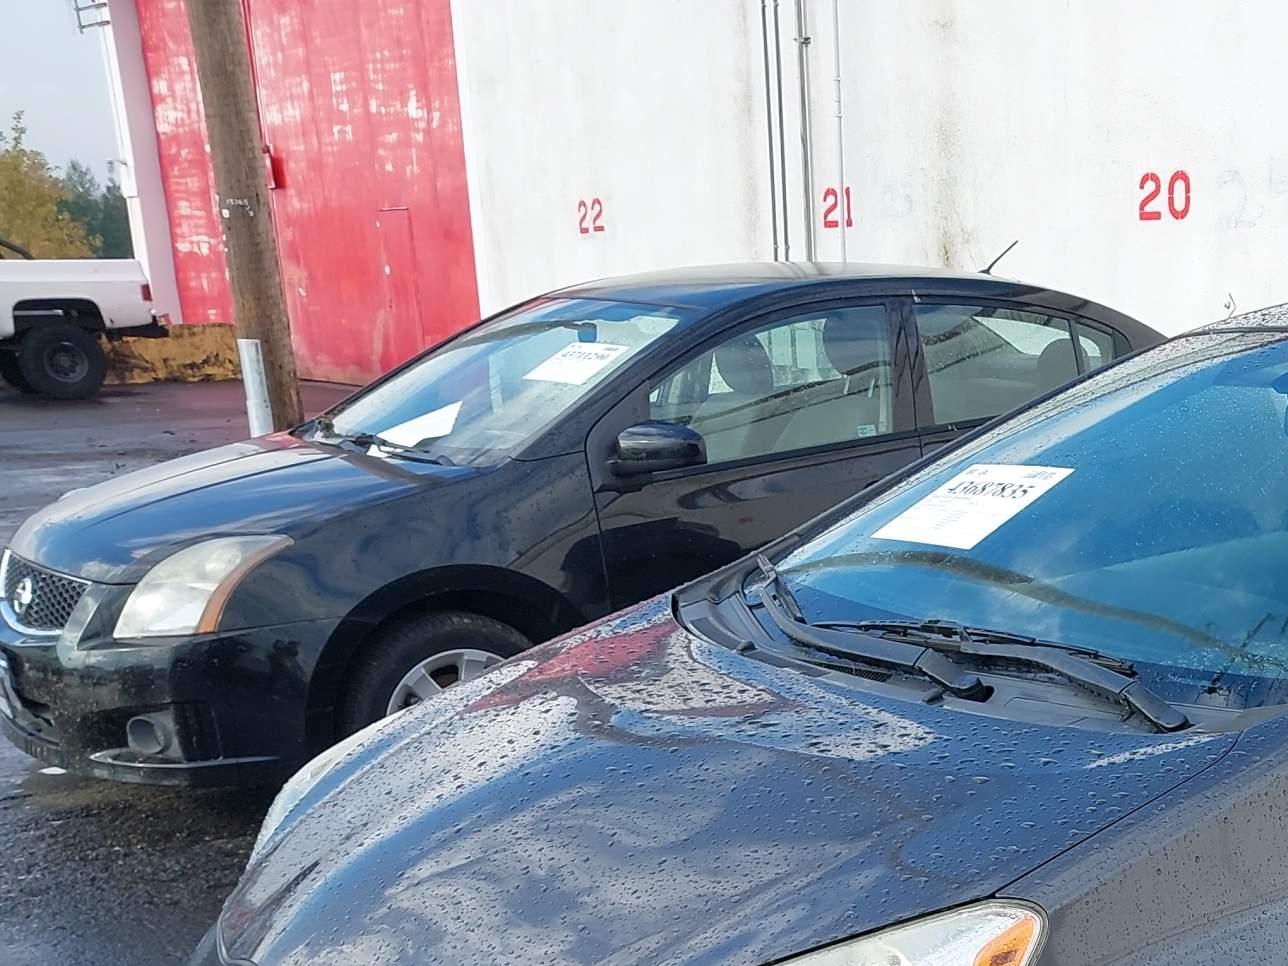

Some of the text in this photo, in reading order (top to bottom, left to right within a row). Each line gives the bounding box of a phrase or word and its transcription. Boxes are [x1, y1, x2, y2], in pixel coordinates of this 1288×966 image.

[823, 186, 853, 229] 21
[1138, 170, 1192, 222] 20
[579, 198, 605, 234] 22
[947, 480, 1036, 500] 43687835
